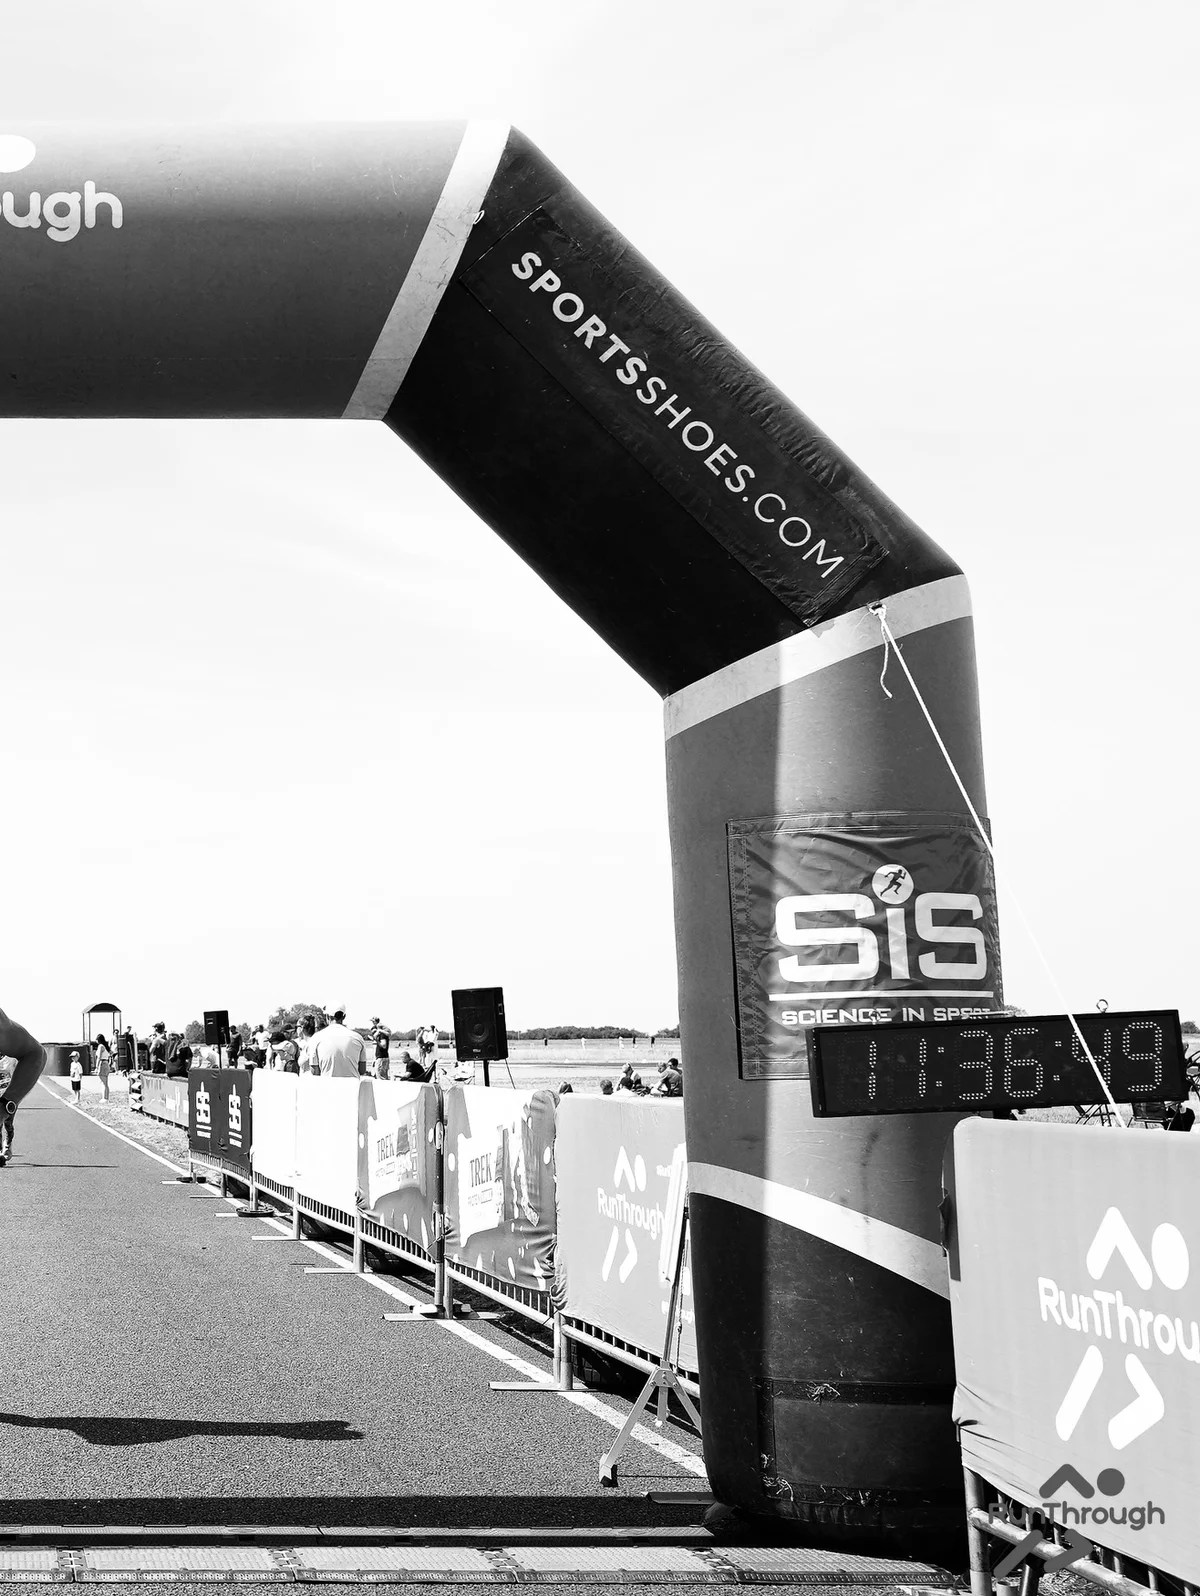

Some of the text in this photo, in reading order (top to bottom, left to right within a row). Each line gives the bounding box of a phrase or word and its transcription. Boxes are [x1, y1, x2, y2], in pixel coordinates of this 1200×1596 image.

[511, 252, 844, 578] SPORTSSHOES.COM
[775, 864, 988, 982] SiS
[781, 1008, 892, 1026] SCIENCE
[902, 1007, 925, 1022] IN
[869, 1020, 1163, 1100] 11:36:49
[469, 1152, 492, 1188] TREK
